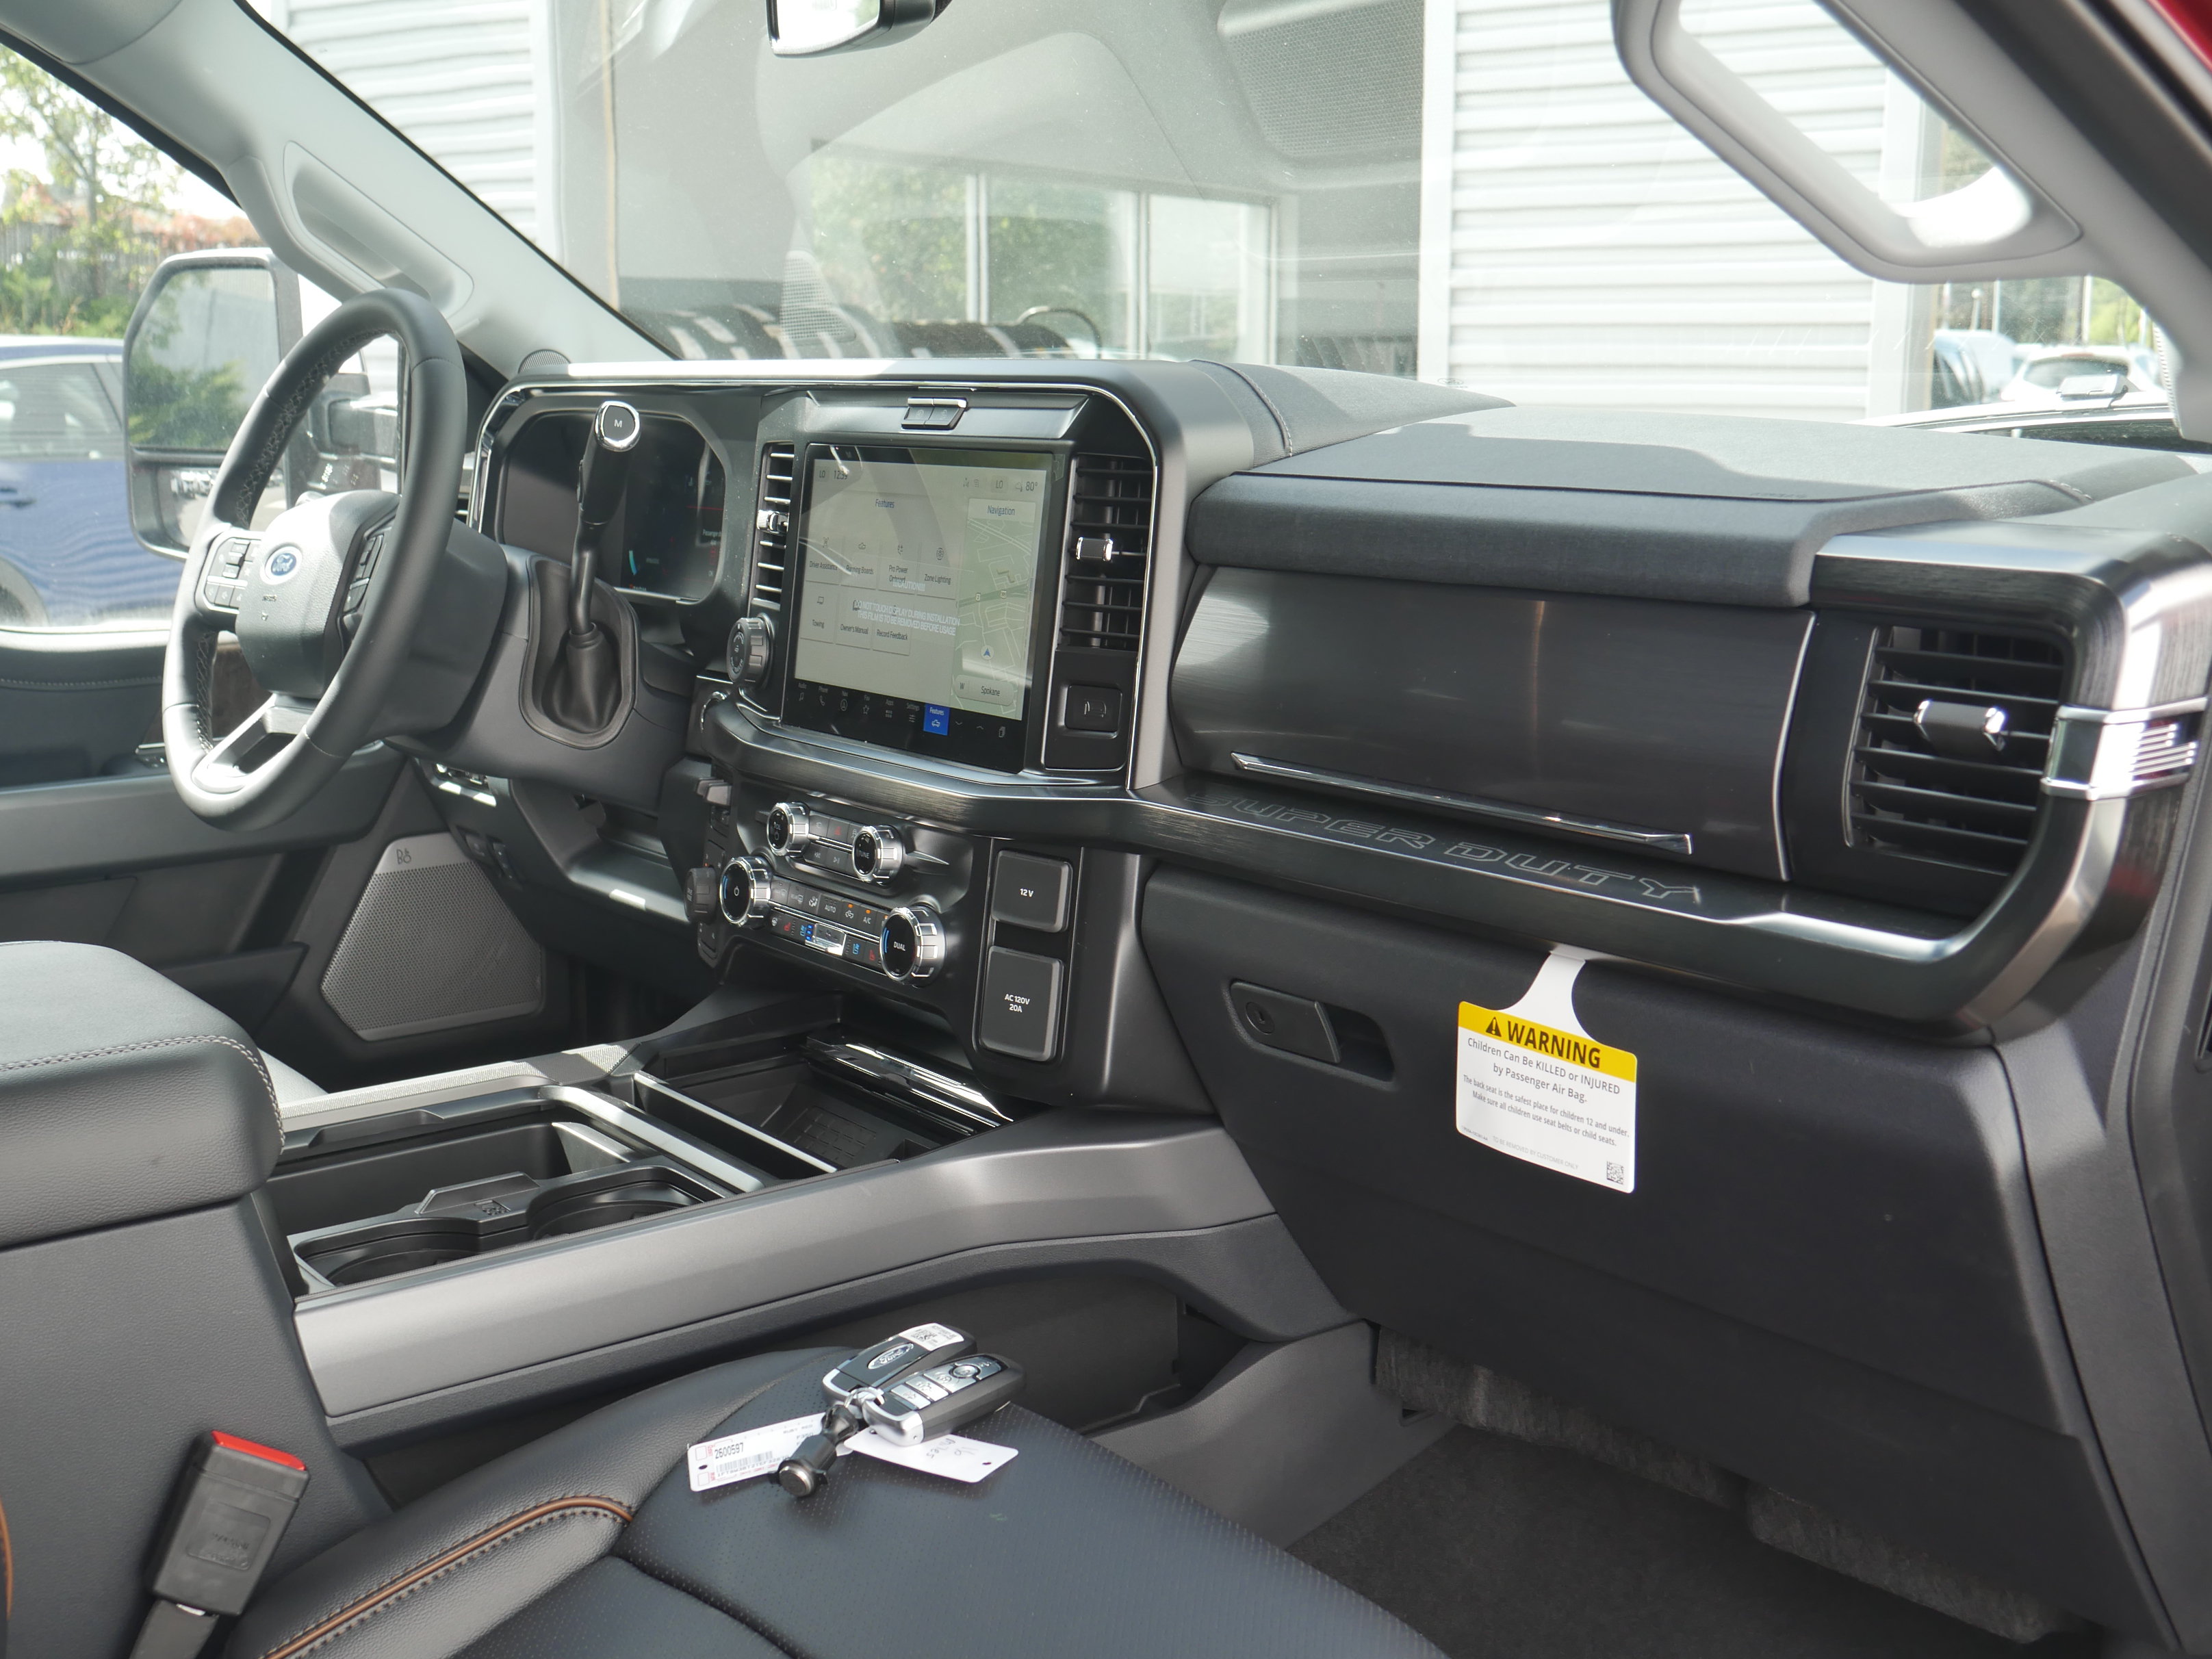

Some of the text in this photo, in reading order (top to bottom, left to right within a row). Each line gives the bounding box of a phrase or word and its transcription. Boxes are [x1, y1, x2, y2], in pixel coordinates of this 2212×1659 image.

[613, 419, 623, 428] M
[995, 480, 1004, 489] LO
[1025, 481, 1038, 492] 80°
[875, 498, 895, 509] Features
[987, 504, 1016, 517] Navigation
[924, 574, 951, 585] Zone Lighting
[960, 682, 965, 691] W
[981, 686, 1001, 697] Spokane
[929, 707, 944, 716] Features
[1184, 794, 1699, 899] SUPER DUTY
[825, 905, 836, 913] AUTO
[863, 916, 872, 925] A/C
[893, 941, 906, 951] DUAL
[1004, 994, 1030, 1005] AC 120V
[1009, 1003, 1023, 1013] 20A
[1508, 1020, 1601, 1068] WARNING
[1467, 1038, 1621, 1094] Children Can Be KILLED or INJURED
[1493, 1062, 1587, 1104] by Passenger Air Bag.
[1463, 1074, 1630, 1137] The back seat is the safest place for children 12 and under.
[1472, 1090, 1486, 1103] Make
[1487, 1097, 1499, 1107] sure
[1508, 1104, 1531, 1118] children
[1532, 1113, 1543, 1123] use
[1543, 1117, 1556, 1128] seat
[1558, 1120, 1572, 1133] belts
[1582, 1129, 1597, 1140] child
[1598, 1135, 1617, 1146] seats.
[1493, 1135, 1499, 1144] TO
[1506, 1141, 1529, 1154] REMOVED
[1536, 1152, 1564, 1166] CUSTOMER
[1565, 1161, 1579, 1170] ONLY
[715, 1442, 744, 1459] 2600597
